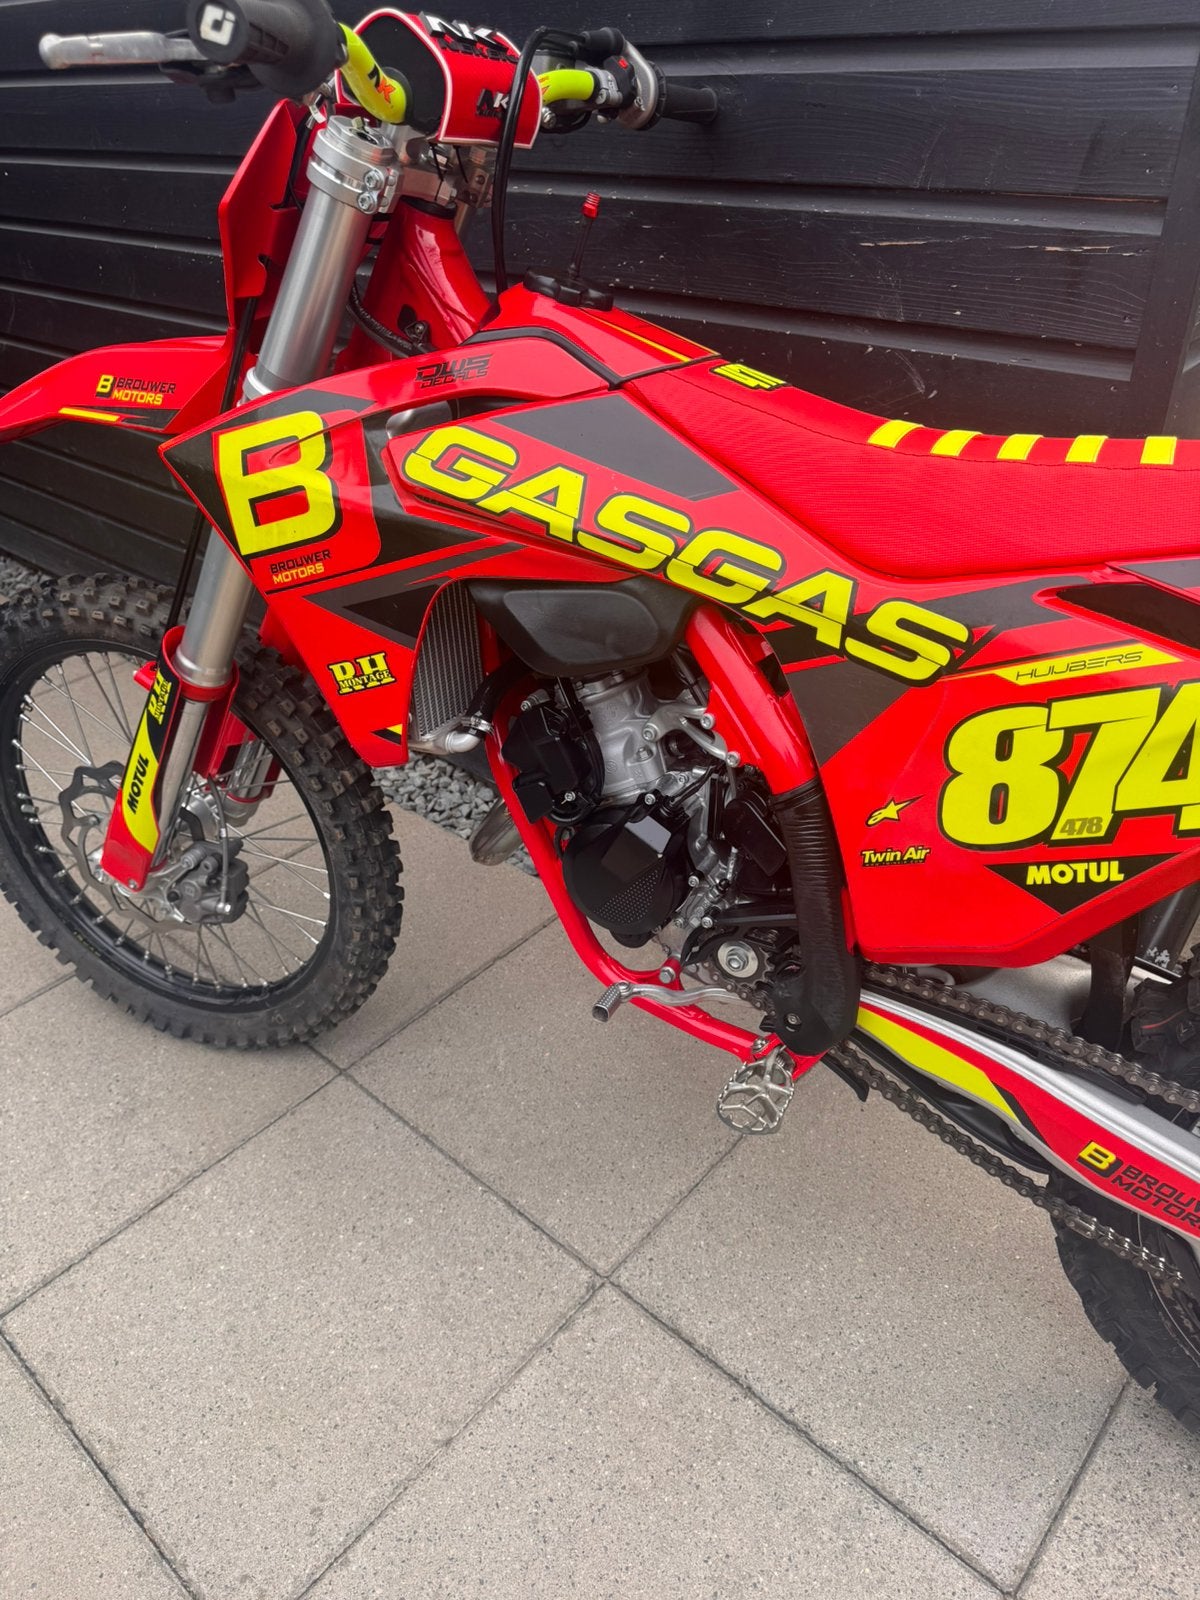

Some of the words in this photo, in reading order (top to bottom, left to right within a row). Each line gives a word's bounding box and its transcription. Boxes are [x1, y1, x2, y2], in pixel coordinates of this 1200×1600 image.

[96, 375, 115, 397] B
[116, 376, 177, 394] BROUWER
[420, 367, 488, 389] DECALS
[112, 389, 164, 406] MOTORS
[218, 410, 338, 556] B
[270, 548, 331, 574] BROUWER
[402, 424, 971, 683] GASGAS
[272, 562, 325, 585] MOTORS
[339, 669, 392, 689] MONTAGE
[940, 681, 1200, 847] 874
[126, 753, 150, 814] MOTUL
[1060, 815, 1103, 836] 478
[862, 848, 901, 864] Twin
[903, 846, 930, 861] Air
[1026, 860, 1125, 885] MOTUL
[1077, 1140, 1121, 1175] B
[1111, 1175, 1200, 1231] MOTOR
